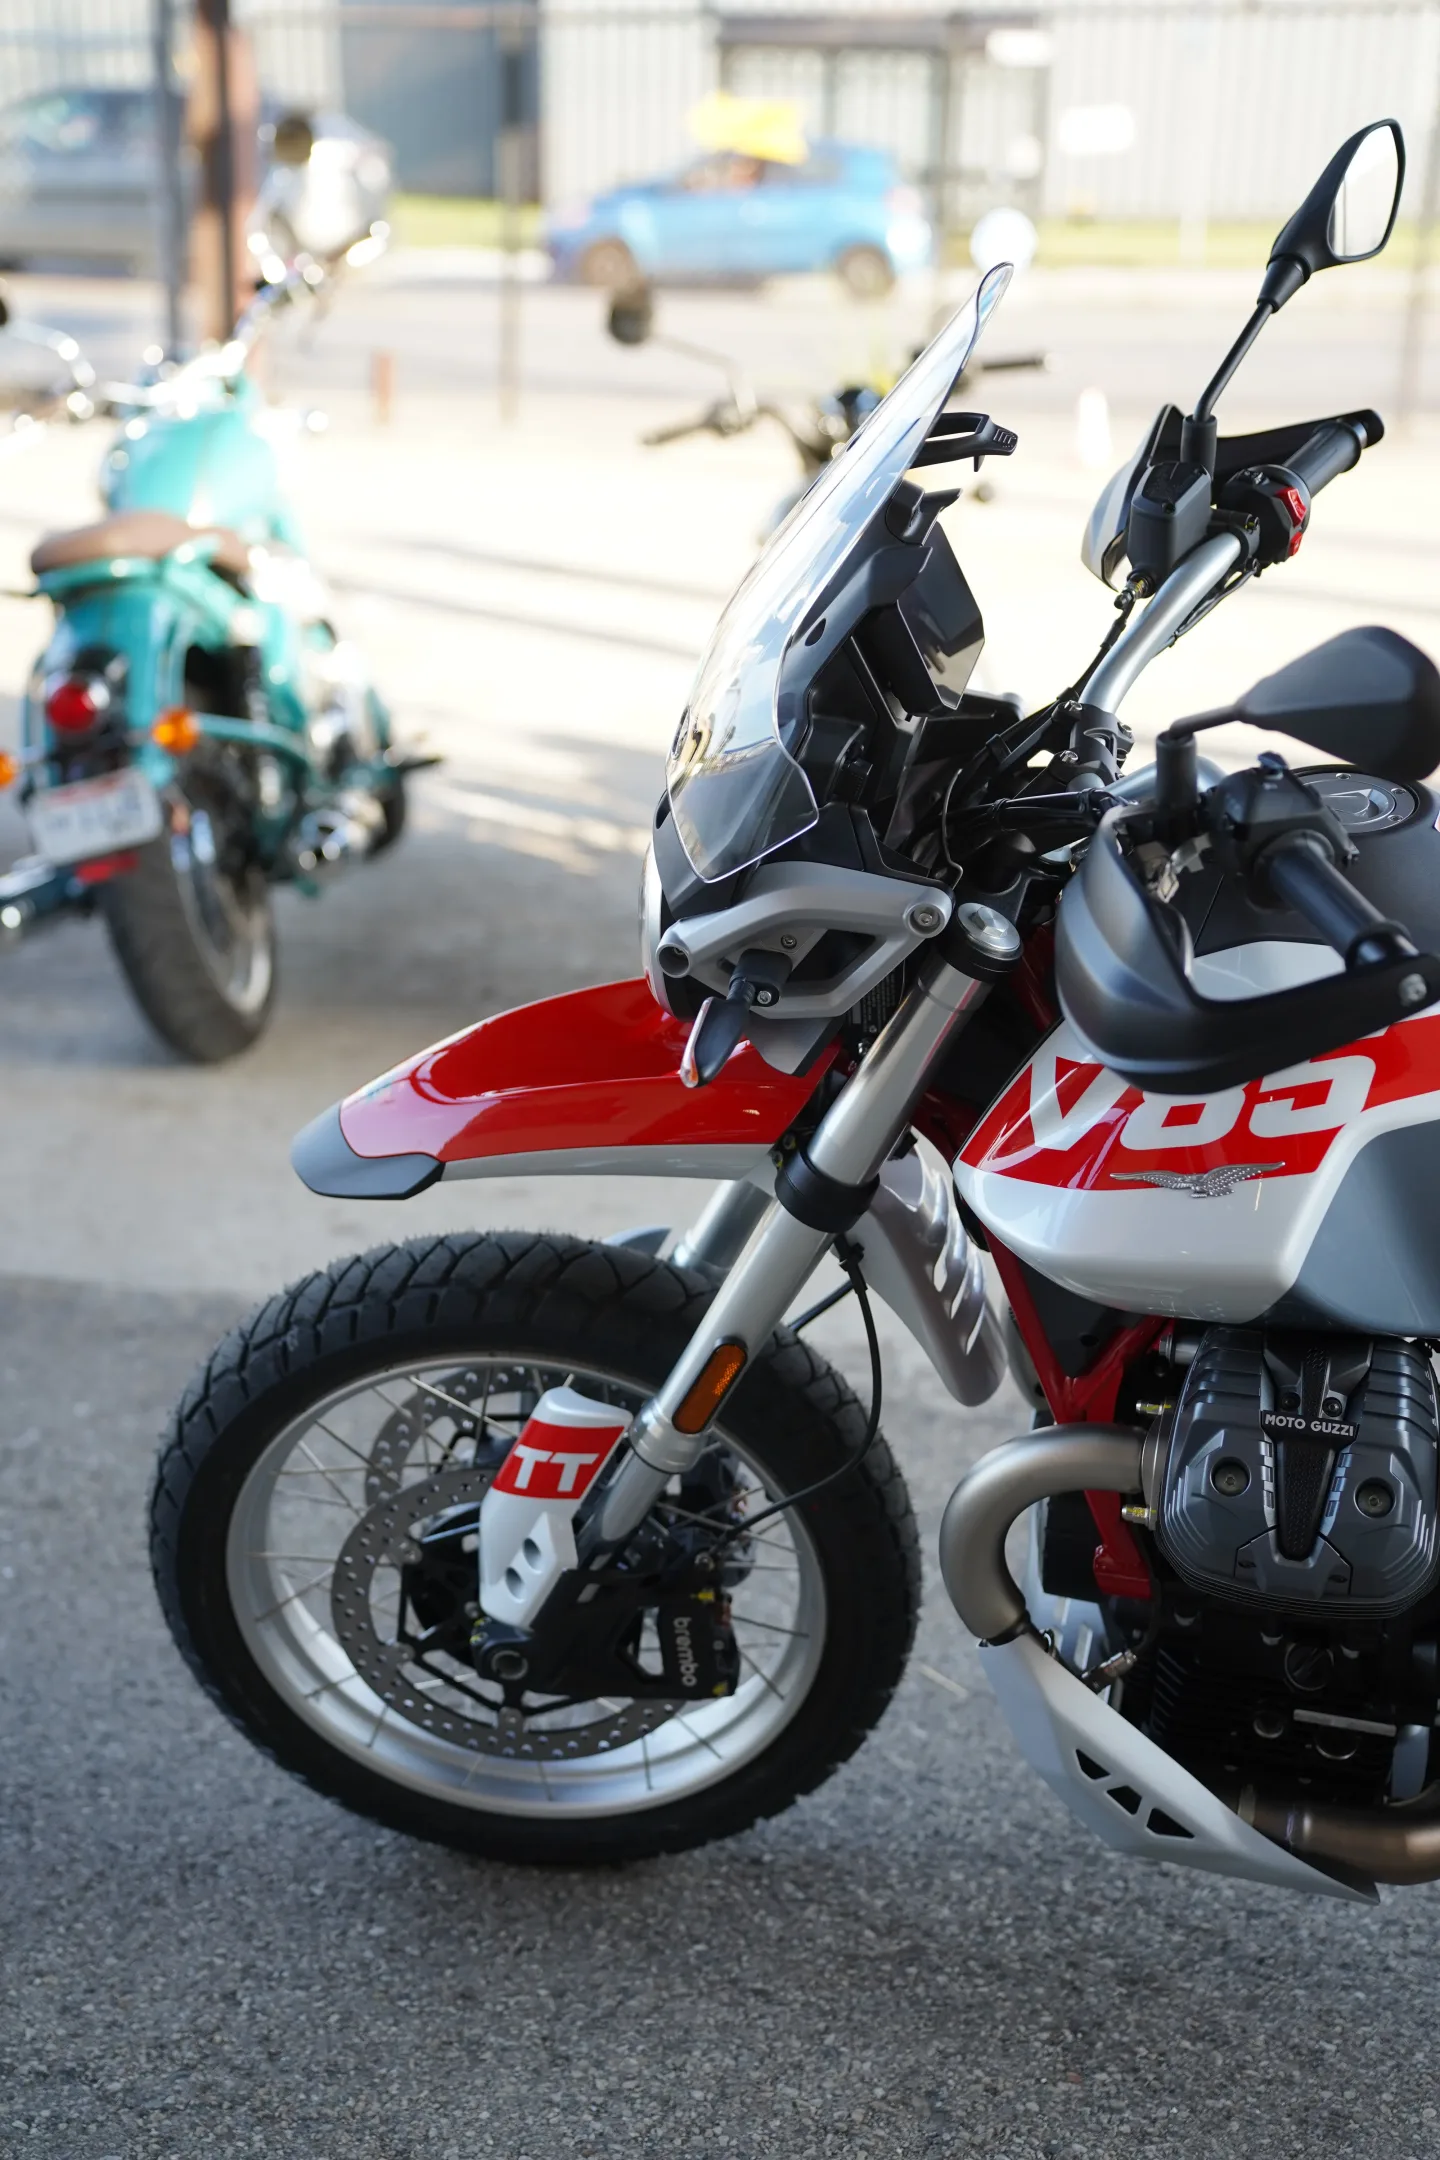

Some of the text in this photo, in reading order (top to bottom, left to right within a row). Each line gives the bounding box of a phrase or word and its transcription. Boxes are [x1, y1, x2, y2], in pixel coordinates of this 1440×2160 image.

[1264, 1414, 1354, 1437] MOTO GUZZI
[513, 1444, 599, 1492] TT
[672, 1616, 700, 1687] brembo
